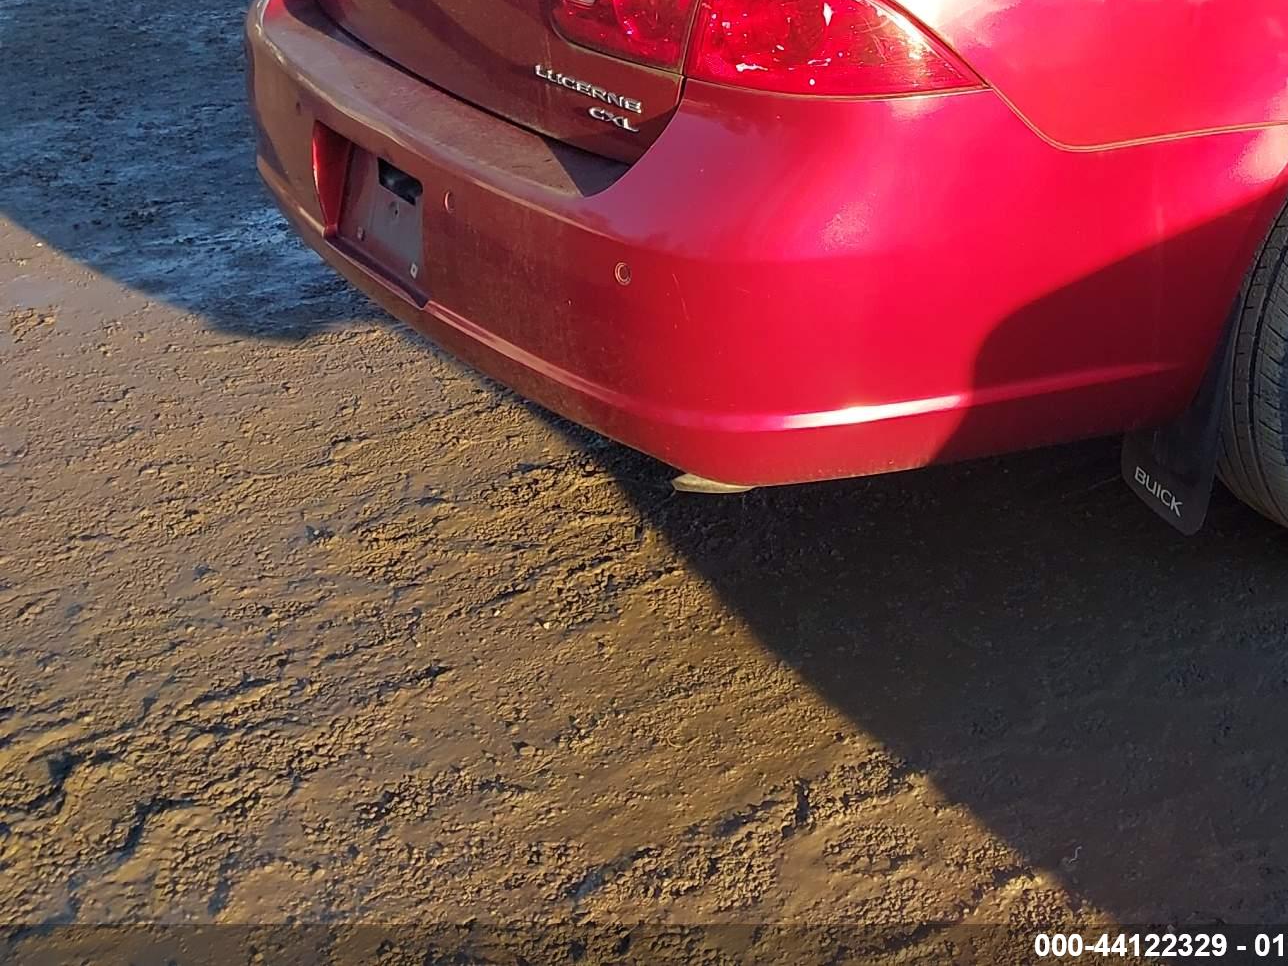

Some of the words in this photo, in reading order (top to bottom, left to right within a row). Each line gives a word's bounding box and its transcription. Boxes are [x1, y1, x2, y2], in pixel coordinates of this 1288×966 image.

[534, 64, 642, 114] LUCERNE
[588, 106, 640, 132] CXL
[1134, 466, 1183, 517] BUICK
